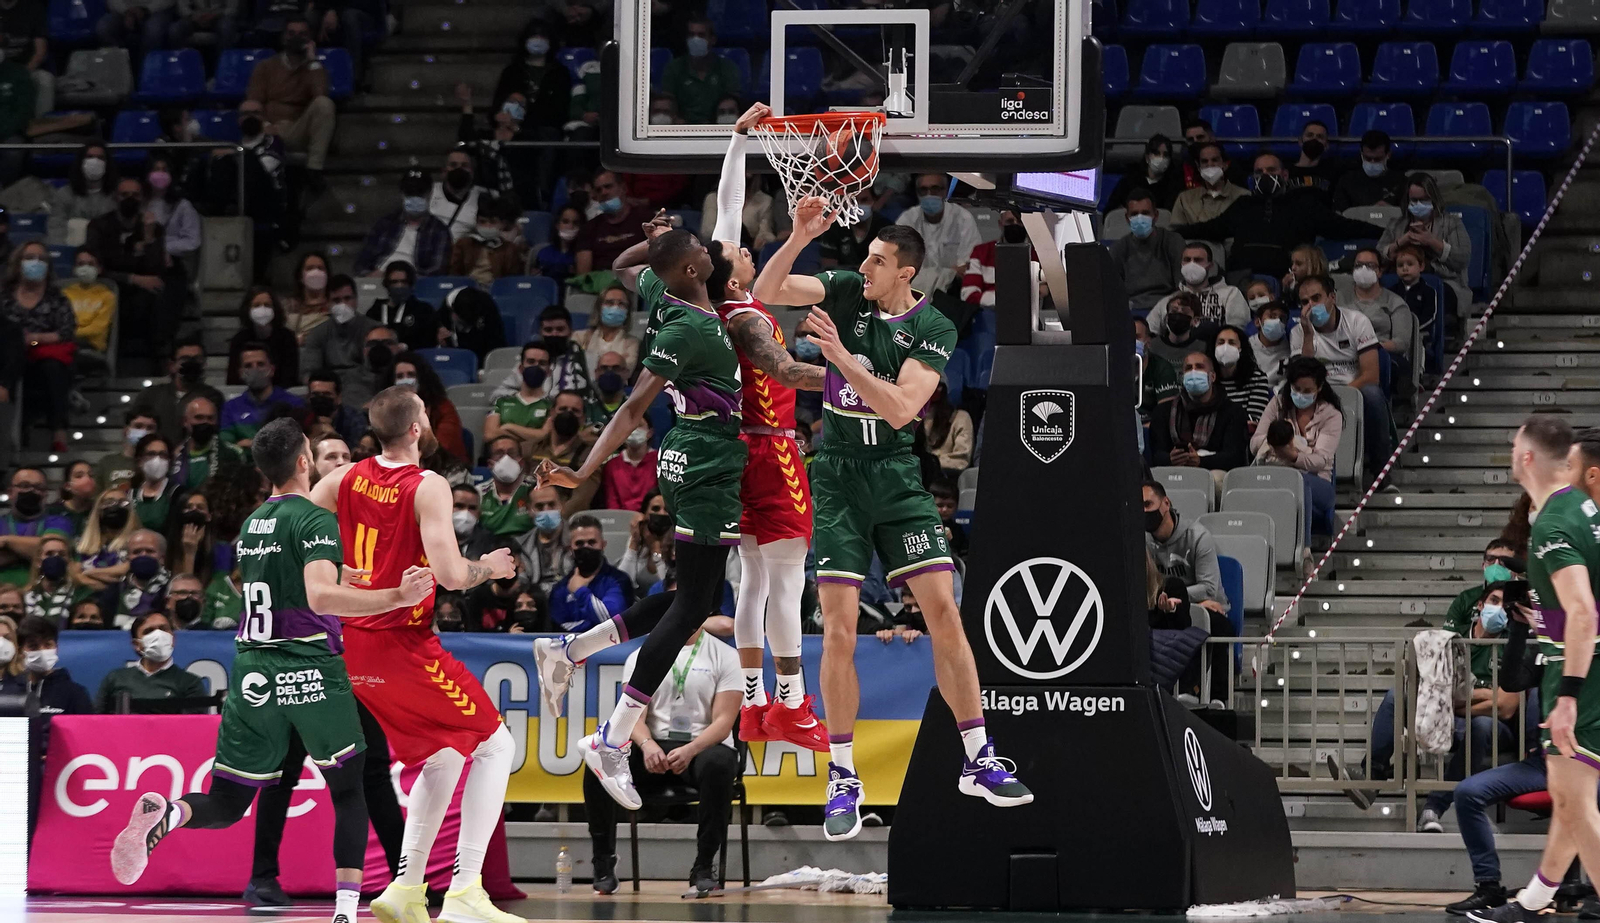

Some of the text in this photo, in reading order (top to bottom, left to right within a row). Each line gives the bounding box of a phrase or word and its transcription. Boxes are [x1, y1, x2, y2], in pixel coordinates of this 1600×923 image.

[1001, 98, 1023, 110] liga
[1001, 109, 1049, 119] endesa
[860, 418, 877, 445] 11
[1032, 425, 1063, 434] Unicaja
[354, 523, 379, 581] 11
[242, 581, 273, 642] 13
[275, 669, 323, 685] COSTA
[276, 681, 325, 696] DEL SOL
[277, 691, 327, 706] MÁLAGA
[981, 690, 1125, 717] álaga Wagen
